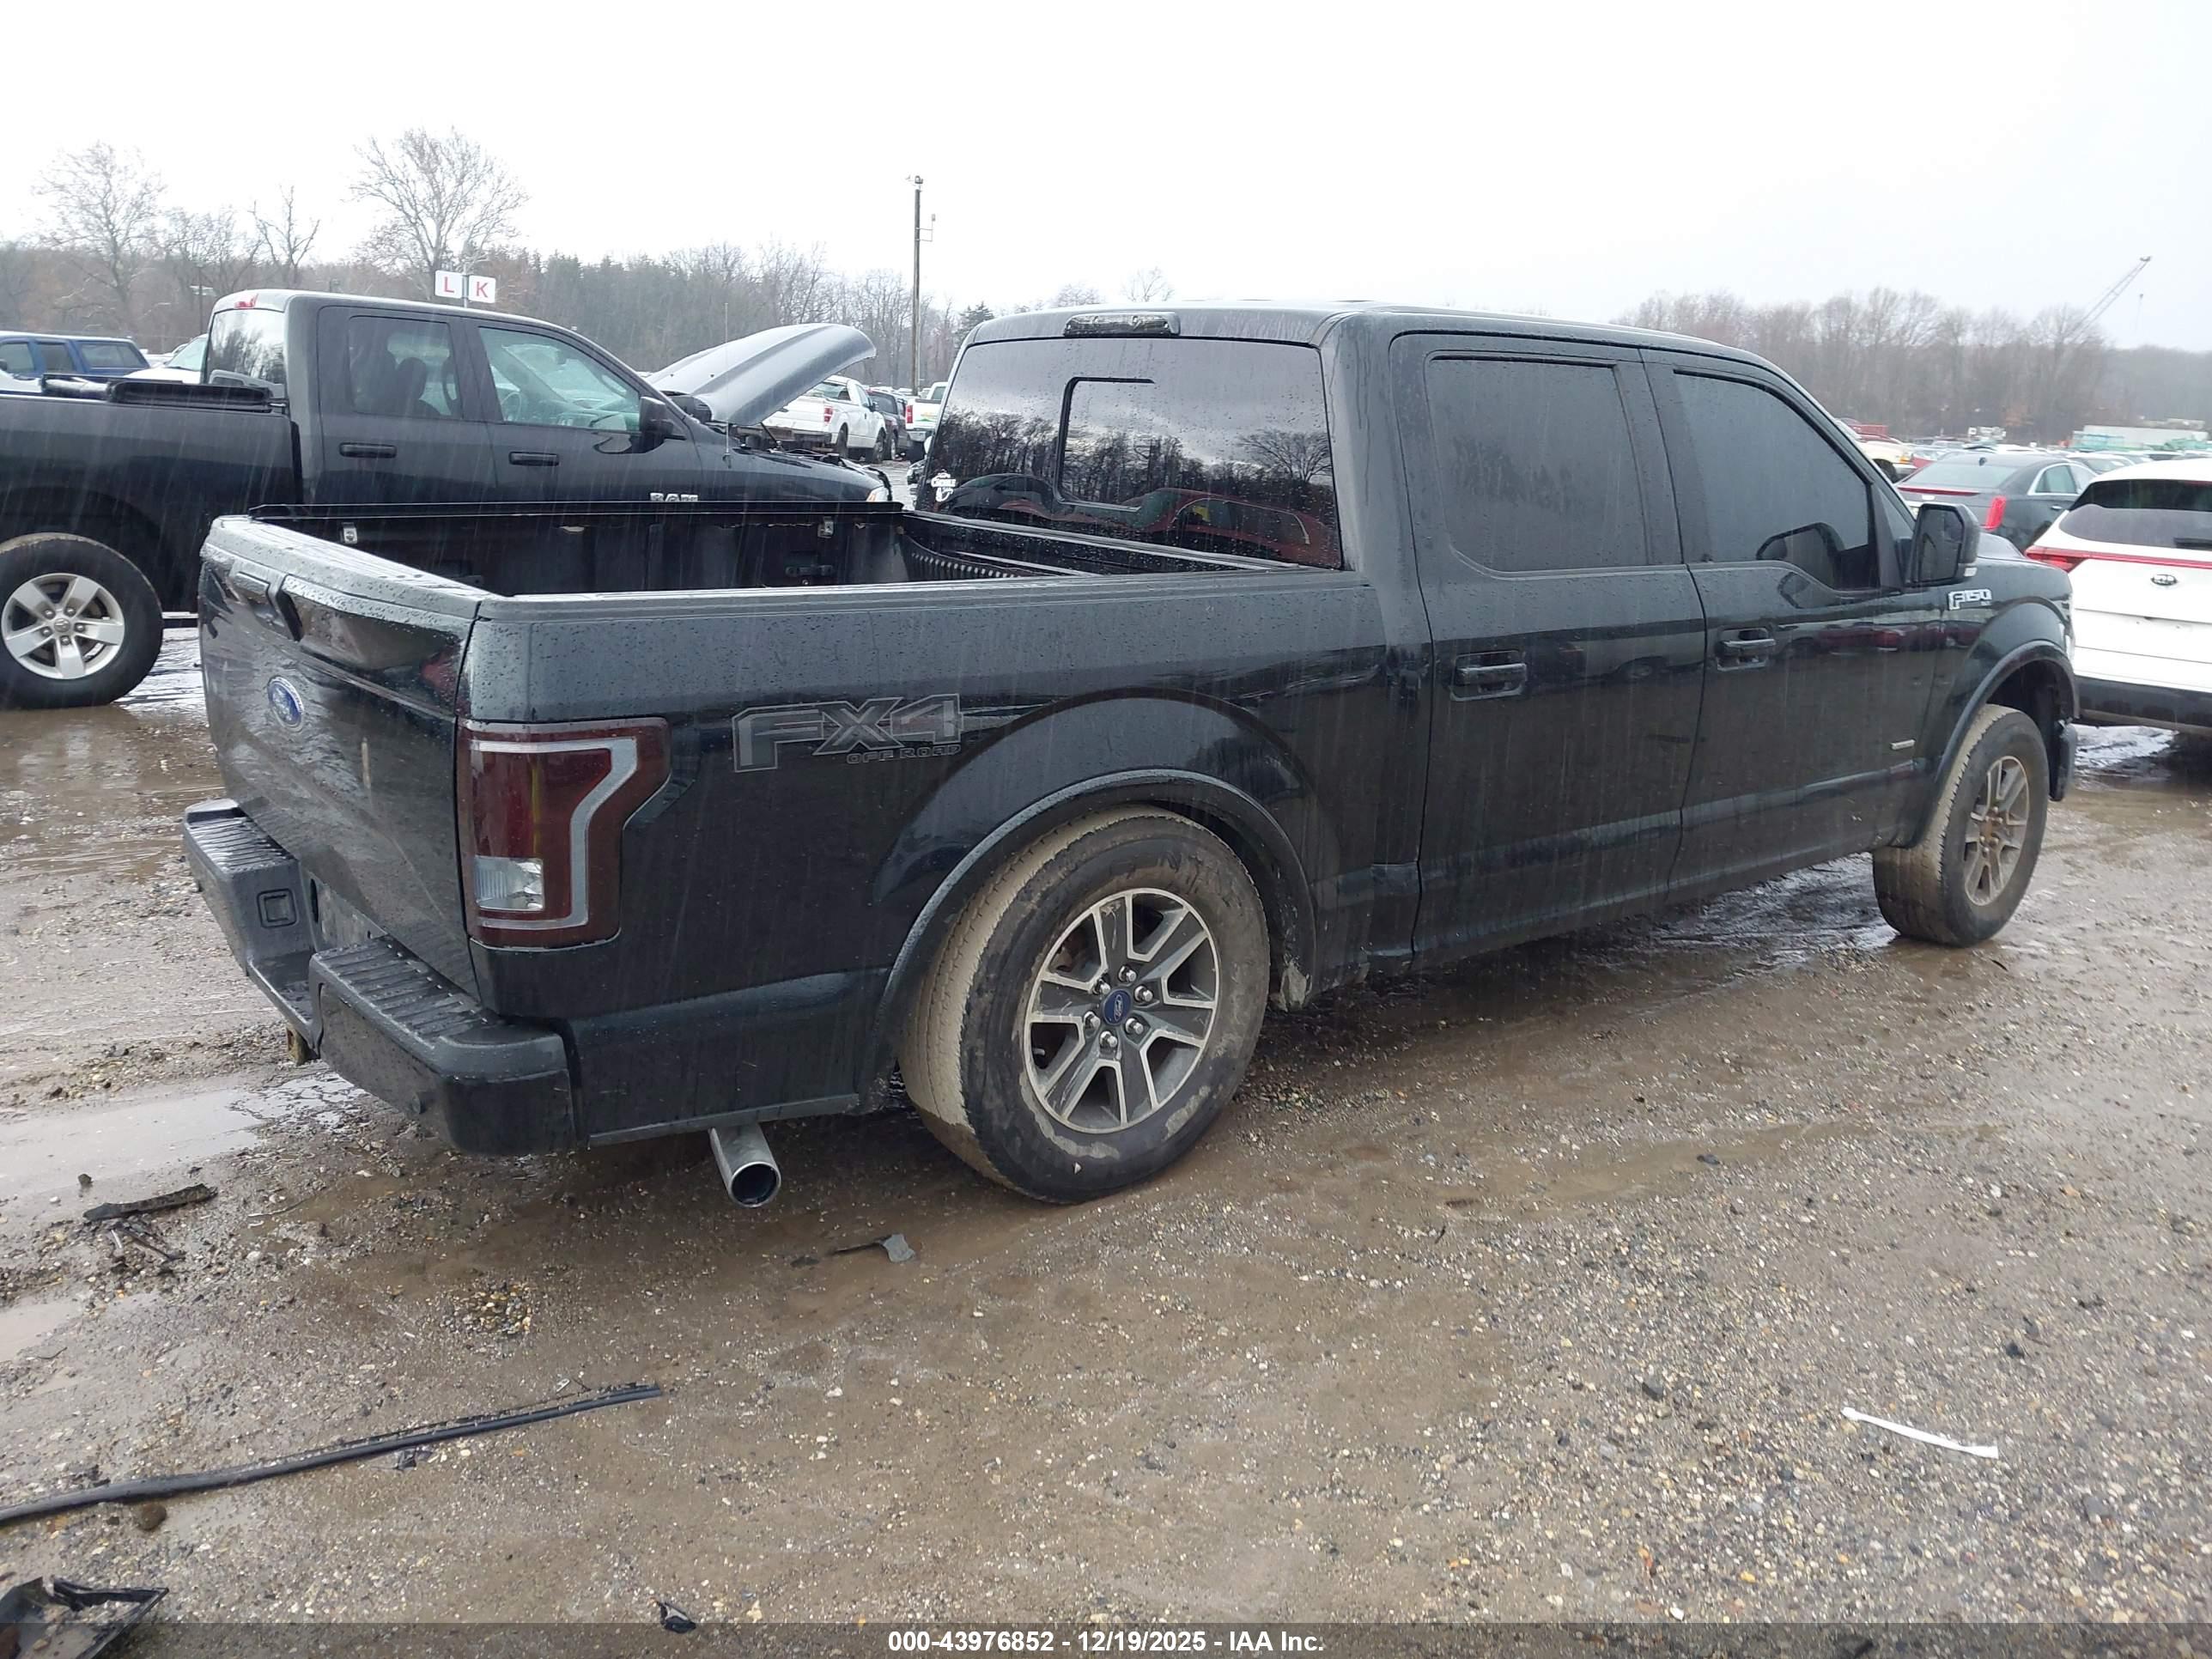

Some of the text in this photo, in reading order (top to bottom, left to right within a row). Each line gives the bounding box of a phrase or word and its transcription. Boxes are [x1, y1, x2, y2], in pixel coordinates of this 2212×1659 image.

[444, 276, 455, 294] L
[476, 281, 489, 298] K
[732, 694, 963, 773] FX4
[846, 744, 962, 764] OFF ROAD
